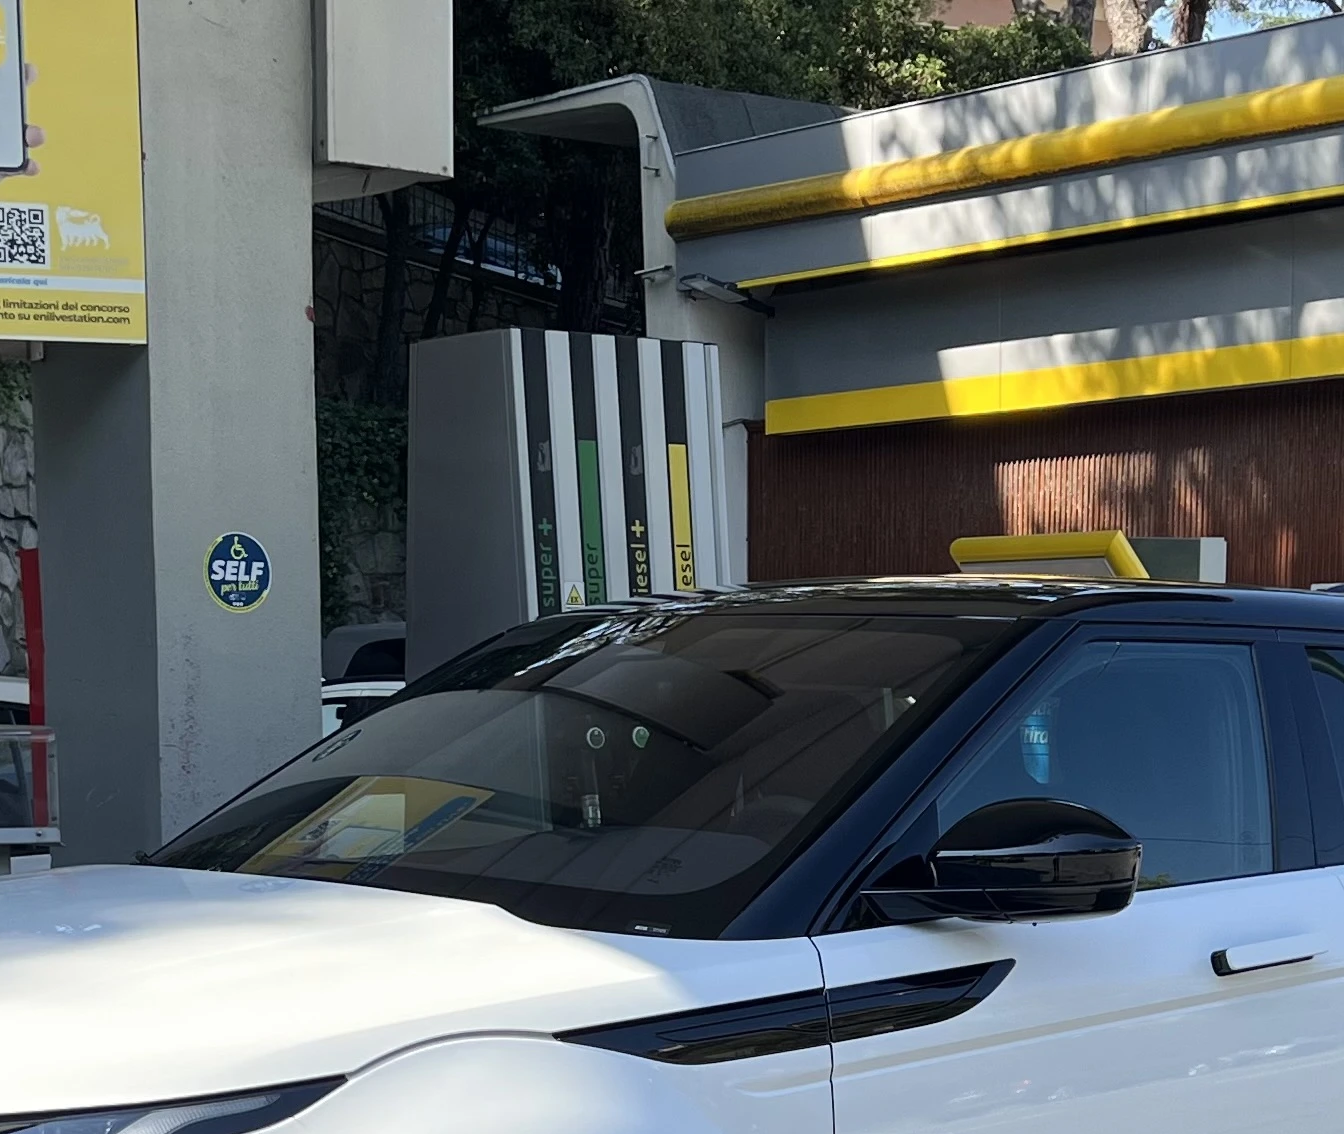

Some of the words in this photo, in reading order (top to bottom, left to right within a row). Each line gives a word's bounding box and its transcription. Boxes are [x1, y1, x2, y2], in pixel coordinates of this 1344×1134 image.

[2, 298, 59, 311] limitazioni
[80, 303, 130, 314] concorso
[17, 312, 31, 321] su
[33, 311, 131, 325] enilivestation.com
[211, 559, 265, 582] SELF
[540, 543, 557, 608] super
[586, 543, 603, 606] super
[630, 543, 649, 594] iesel
[676, 544, 693, 587] esel
[221, 583, 236, 596] per
[238, 580, 259, 591] tutti
